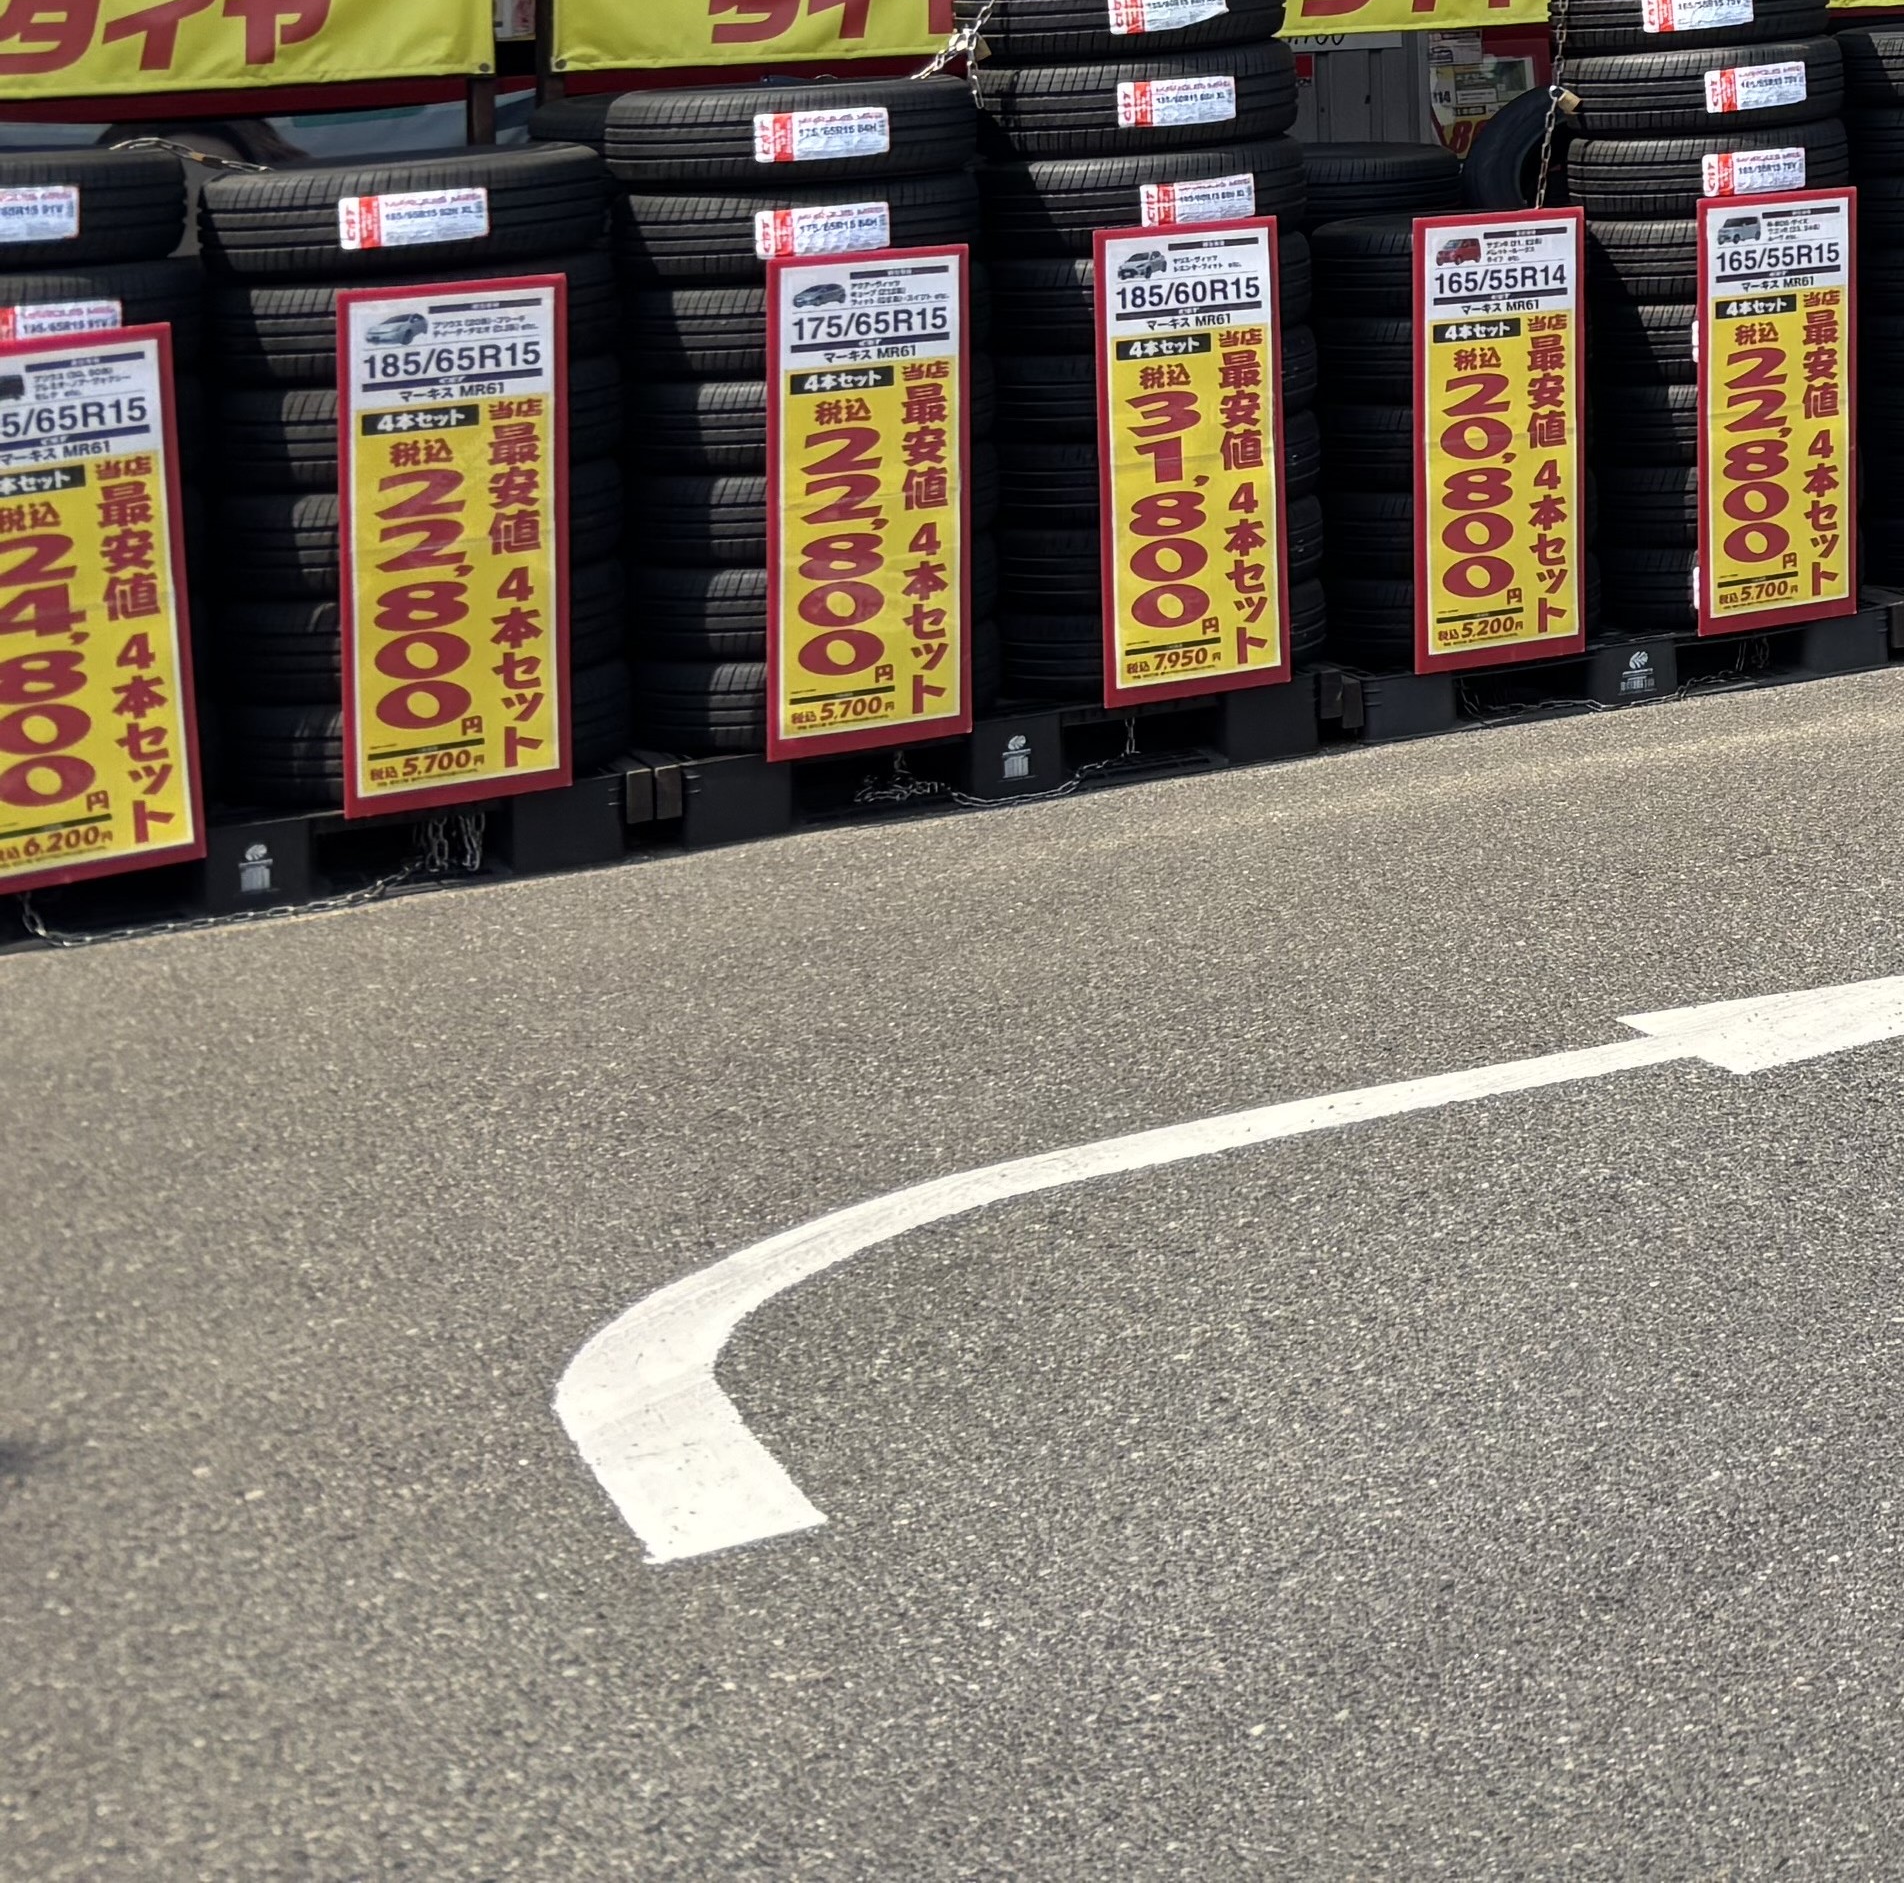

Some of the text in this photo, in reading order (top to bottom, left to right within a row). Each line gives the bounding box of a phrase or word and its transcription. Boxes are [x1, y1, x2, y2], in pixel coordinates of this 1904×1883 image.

[1715, 242, 1840, 274] 165/55R15
[1116, 276, 1261, 310] 185/60R15
[1433, 263, 1567, 295] 165/55R14
[792, 306, 948, 341] 175/65R15
[363, 340, 541, 379] 185/65R15
[1129, 335, 1200, 357] 4本セット
[803, 371, 882, 393] 4本セット
[377, 410, 465, 431] 4本セット
[389, 438, 454, 468] 税込
[1803, 311, 1840, 596] 最安値 4本セット
[1526, 334, 1568, 633] 最安値 4本セット
[1218, 350, 1268, 664] 最安値 4本セット
[901, 383, 949, 714] 最安値 4本セット
[487, 422, 543, 769] 最安値 4本セット
[97, 481, 175, 845] 最安値 4本セット
